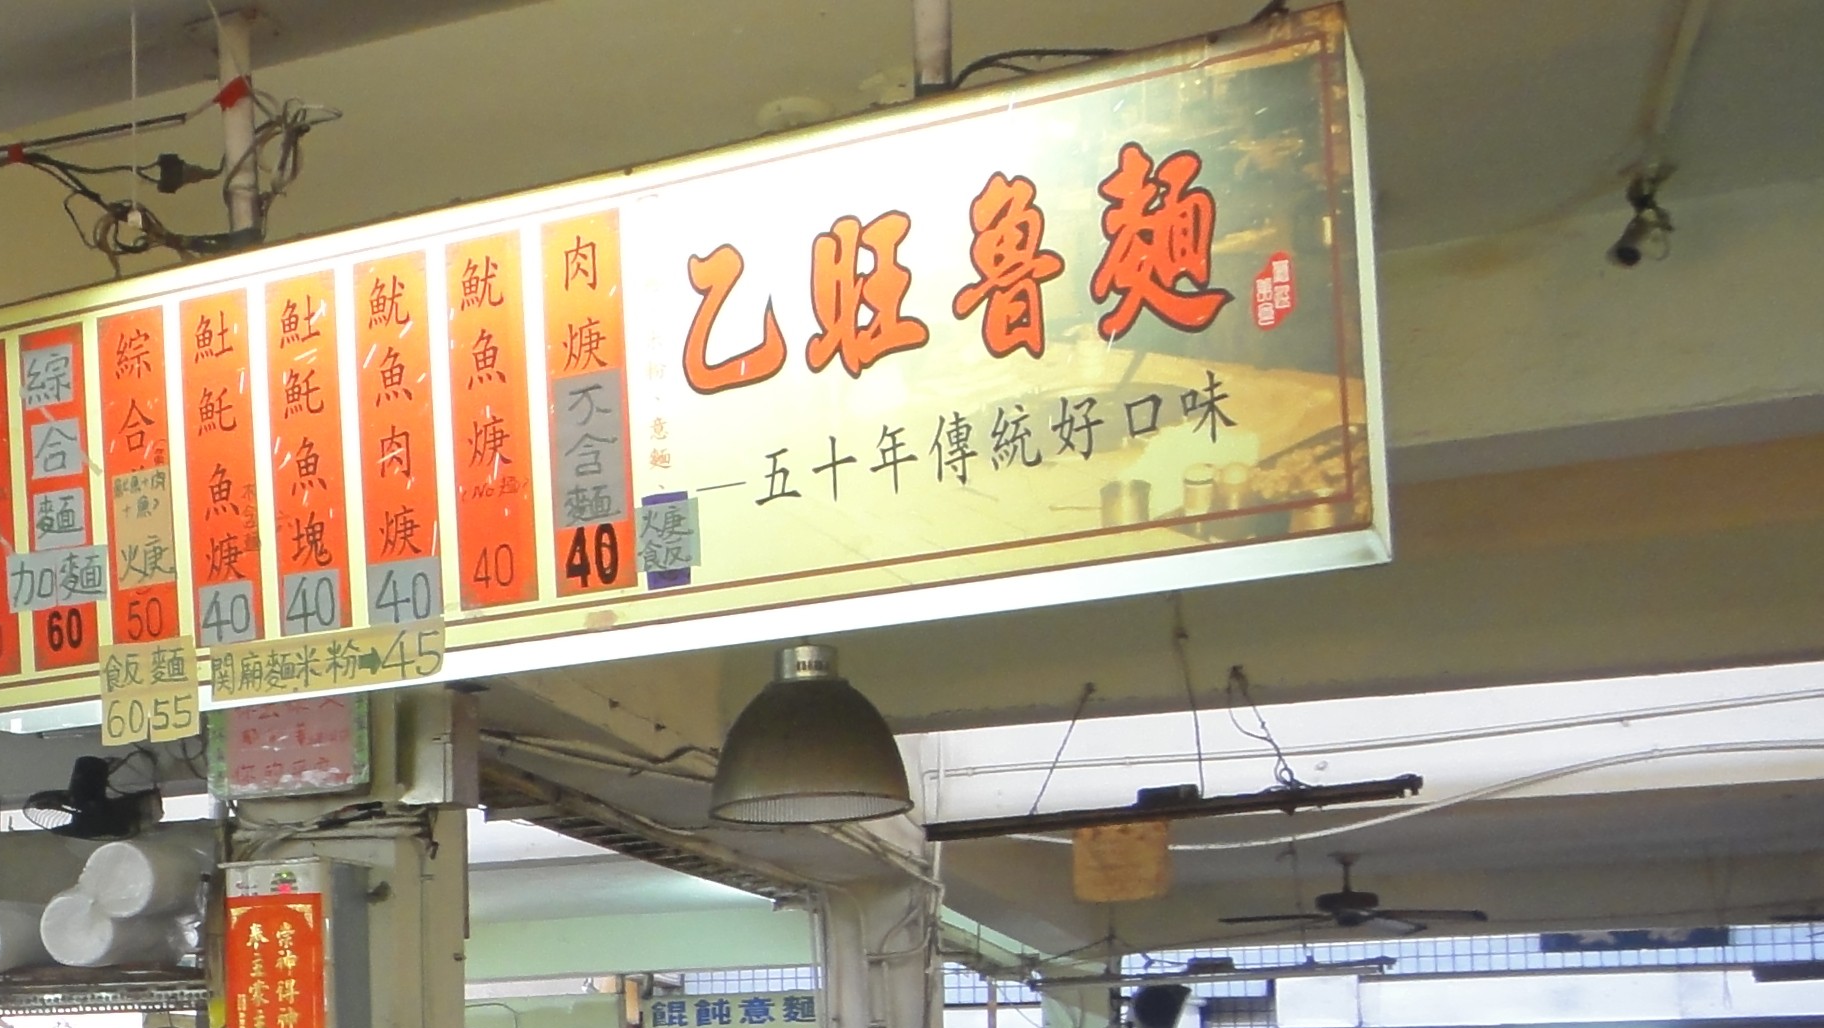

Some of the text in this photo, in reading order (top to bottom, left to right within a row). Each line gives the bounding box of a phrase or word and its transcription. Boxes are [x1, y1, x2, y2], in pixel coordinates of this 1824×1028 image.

[683, 142, 1234, 395] 乙旺魯麵
[473, 543, 515, 589] 40
[566, 523, 619, 588] 40
[128, 596, 164, 641] 50
[202, 590, 251, 643] 40
[286, 576, 336, 634] 40
[376, 569, 432, 624] 40
[46, 607, 84, 652] 60
[651, 995, 817, 1028] 餛飩意麵
